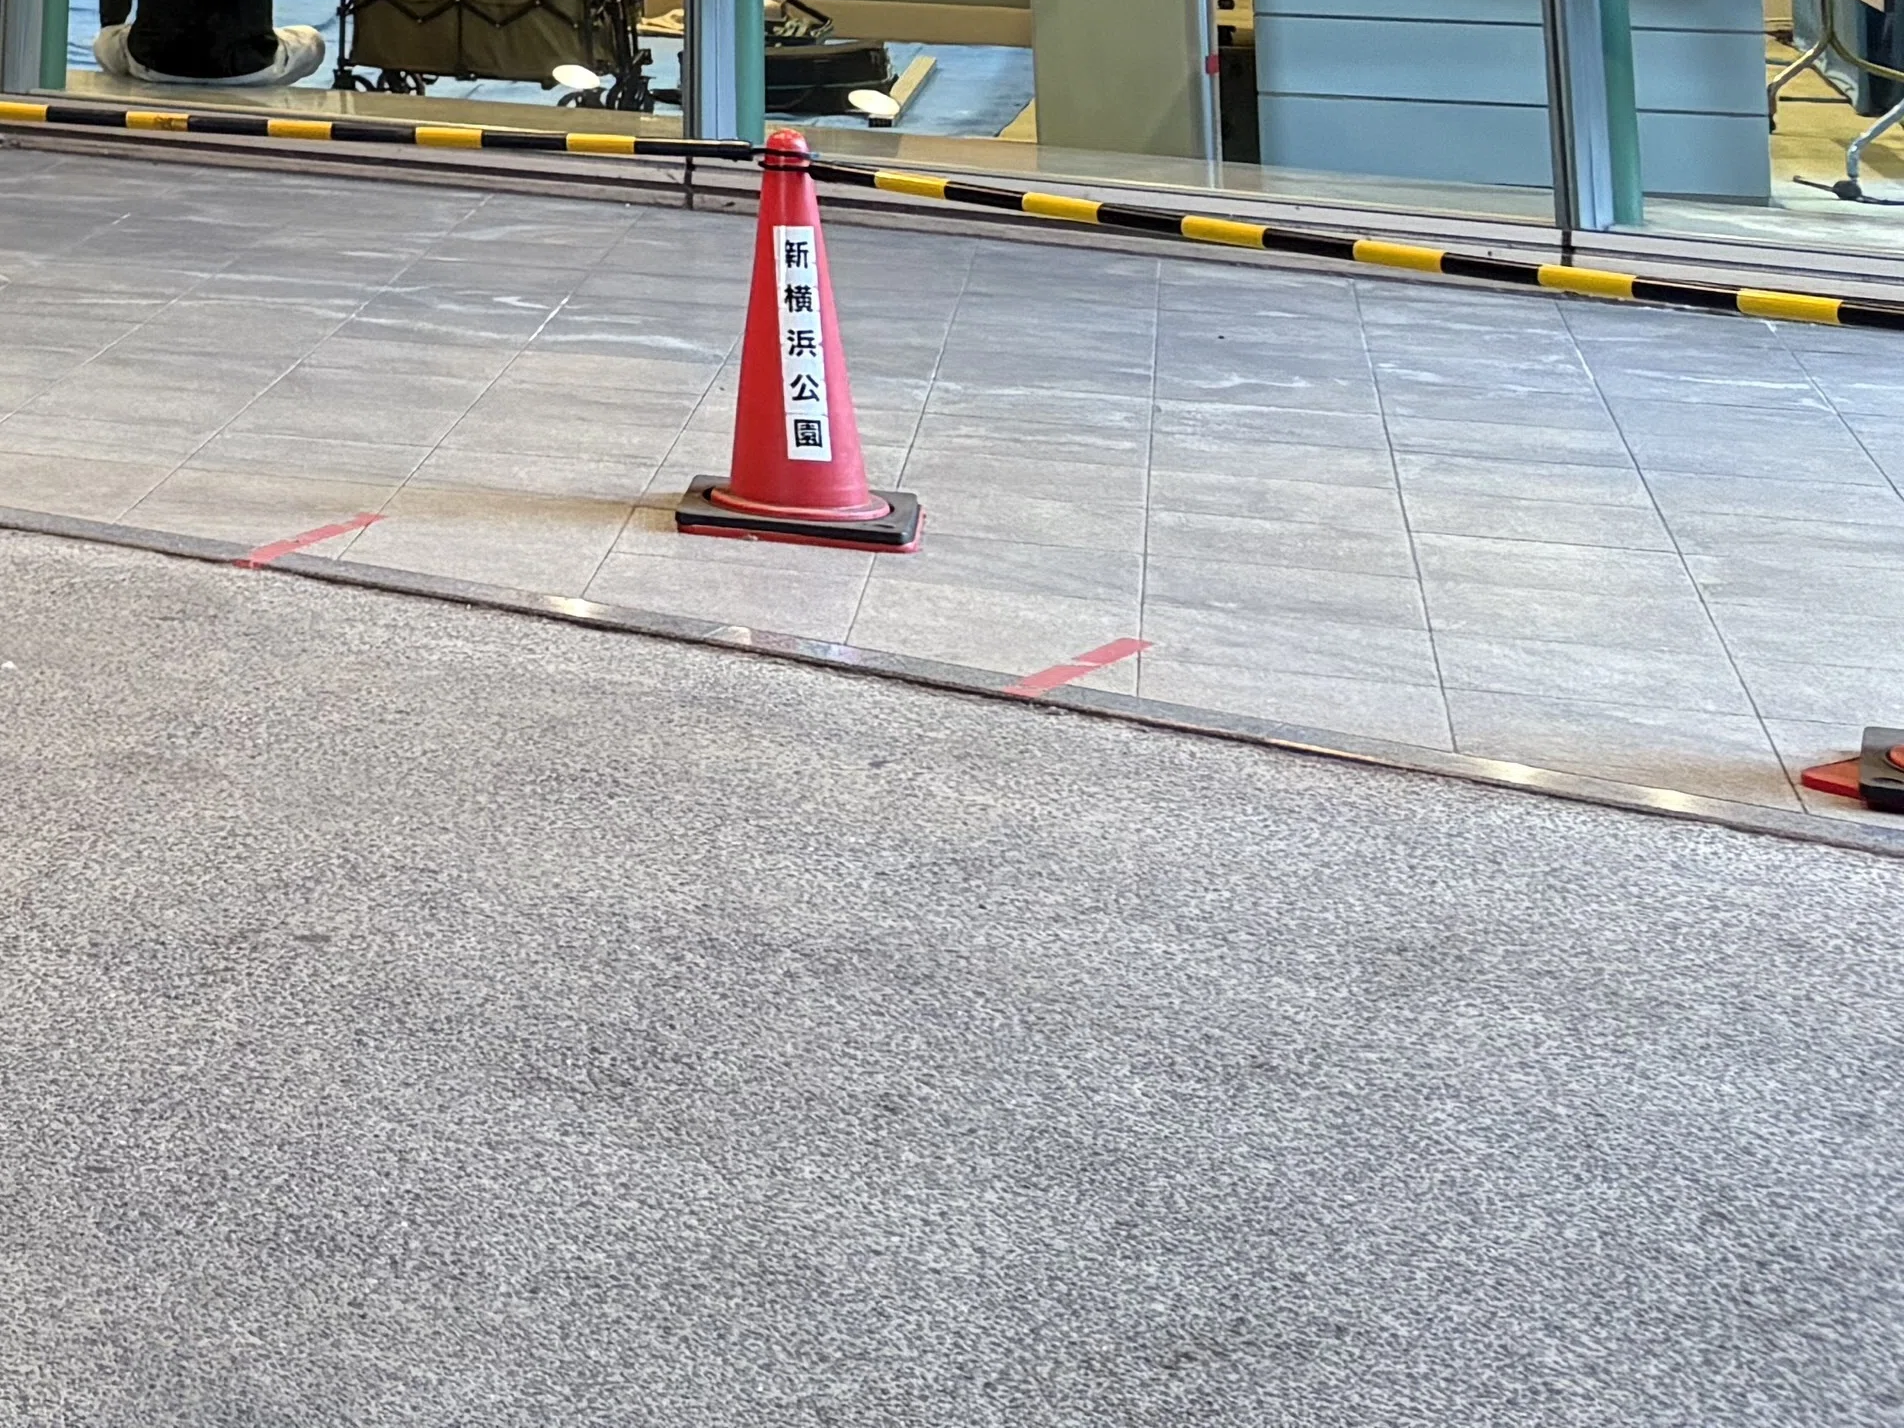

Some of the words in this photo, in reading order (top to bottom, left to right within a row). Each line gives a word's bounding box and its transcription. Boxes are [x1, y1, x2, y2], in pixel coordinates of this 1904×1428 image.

[784, 240, 823, 449] 新横浜公園
